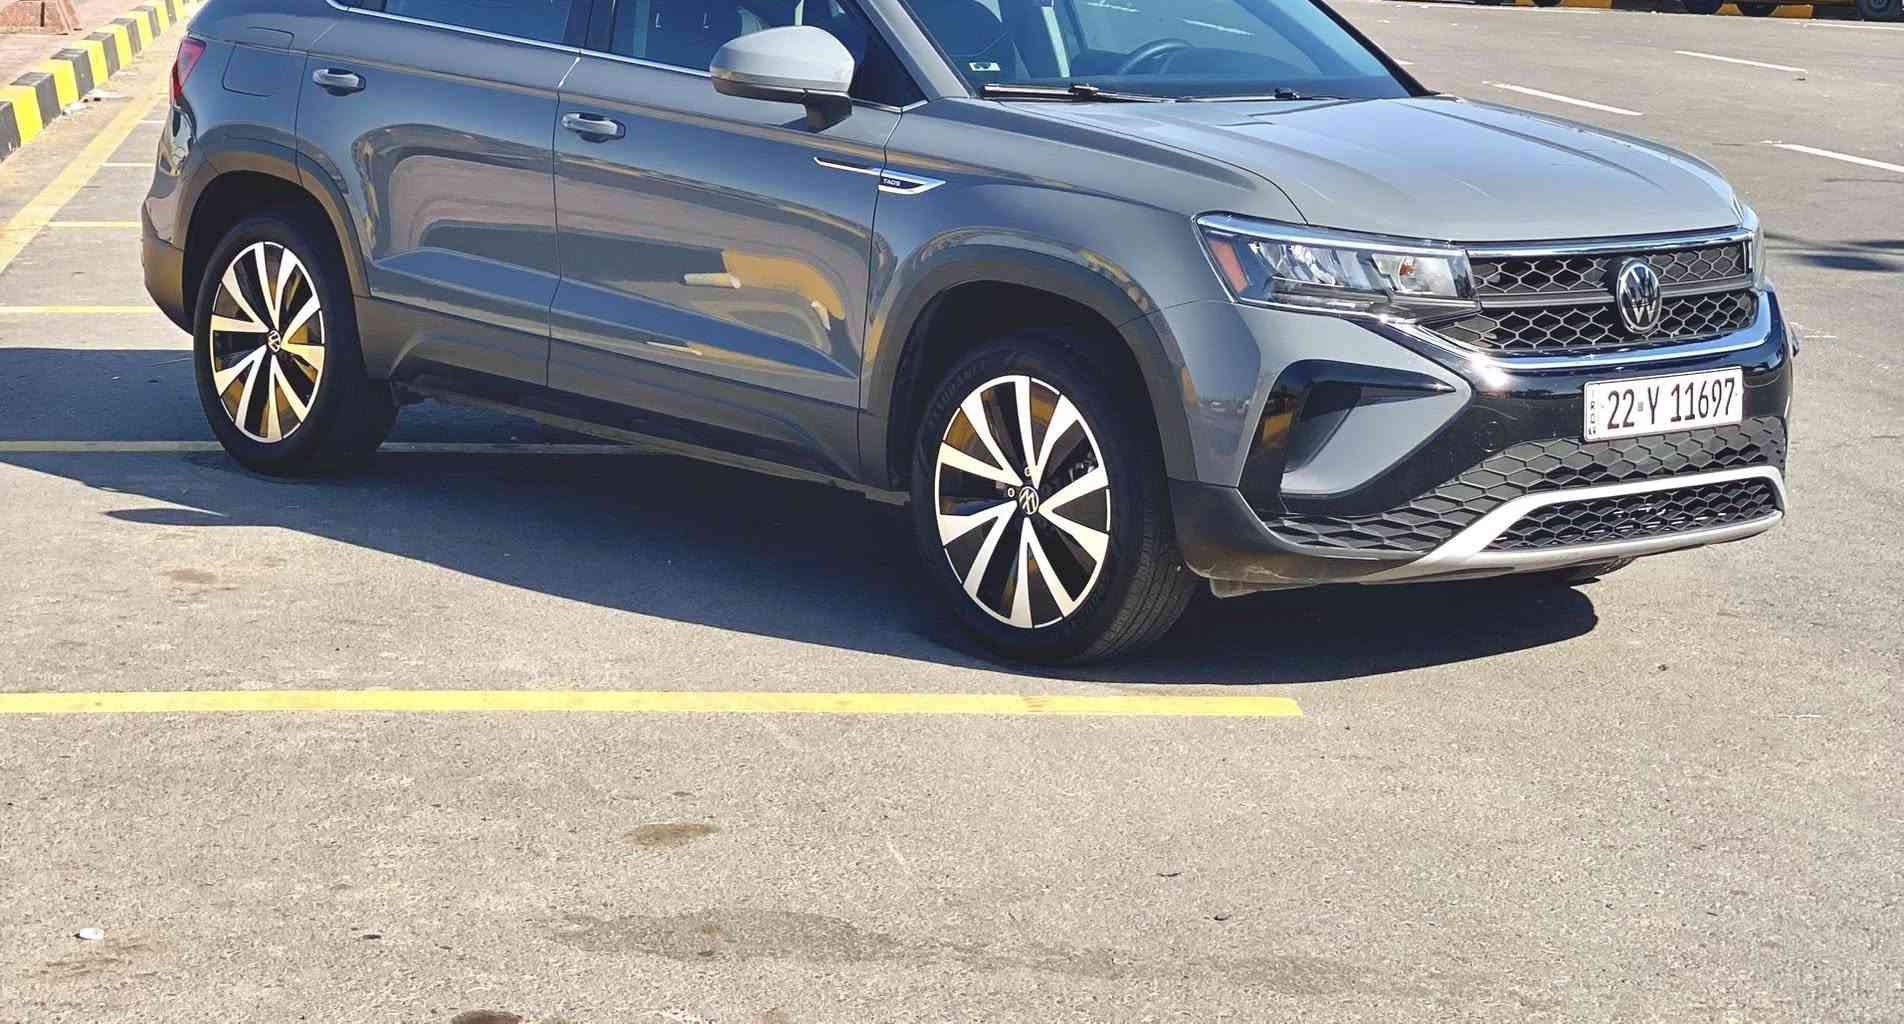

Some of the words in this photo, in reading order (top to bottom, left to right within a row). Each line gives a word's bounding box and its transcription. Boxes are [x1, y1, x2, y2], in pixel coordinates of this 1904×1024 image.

[1607, 388, 1635, 429] 22
[1648, 386, 1660, 424] Y
[1670, 377, 1735, 422] 11697
